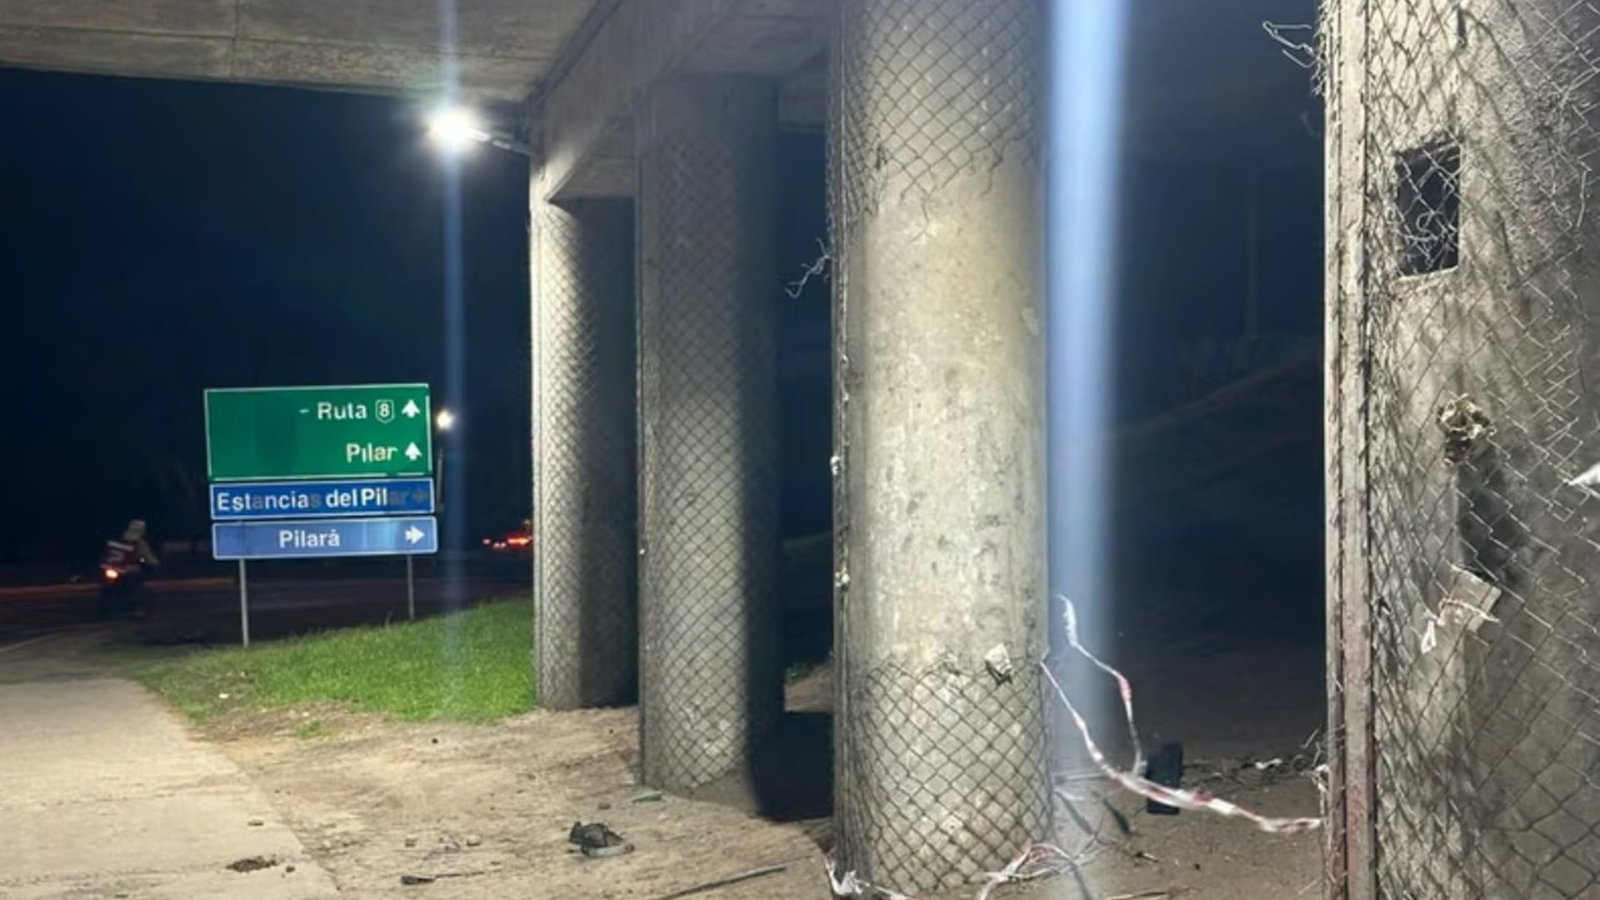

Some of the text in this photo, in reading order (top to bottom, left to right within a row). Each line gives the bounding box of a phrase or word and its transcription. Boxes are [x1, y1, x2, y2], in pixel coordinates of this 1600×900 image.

[317, 401, 367, 419] Ruta
[379, 403, 391, 417] 8
[346, 443, 398, 463] Pilar
[326, 488, 358, 508] del
[279, 529, 340, 549] Pilará
